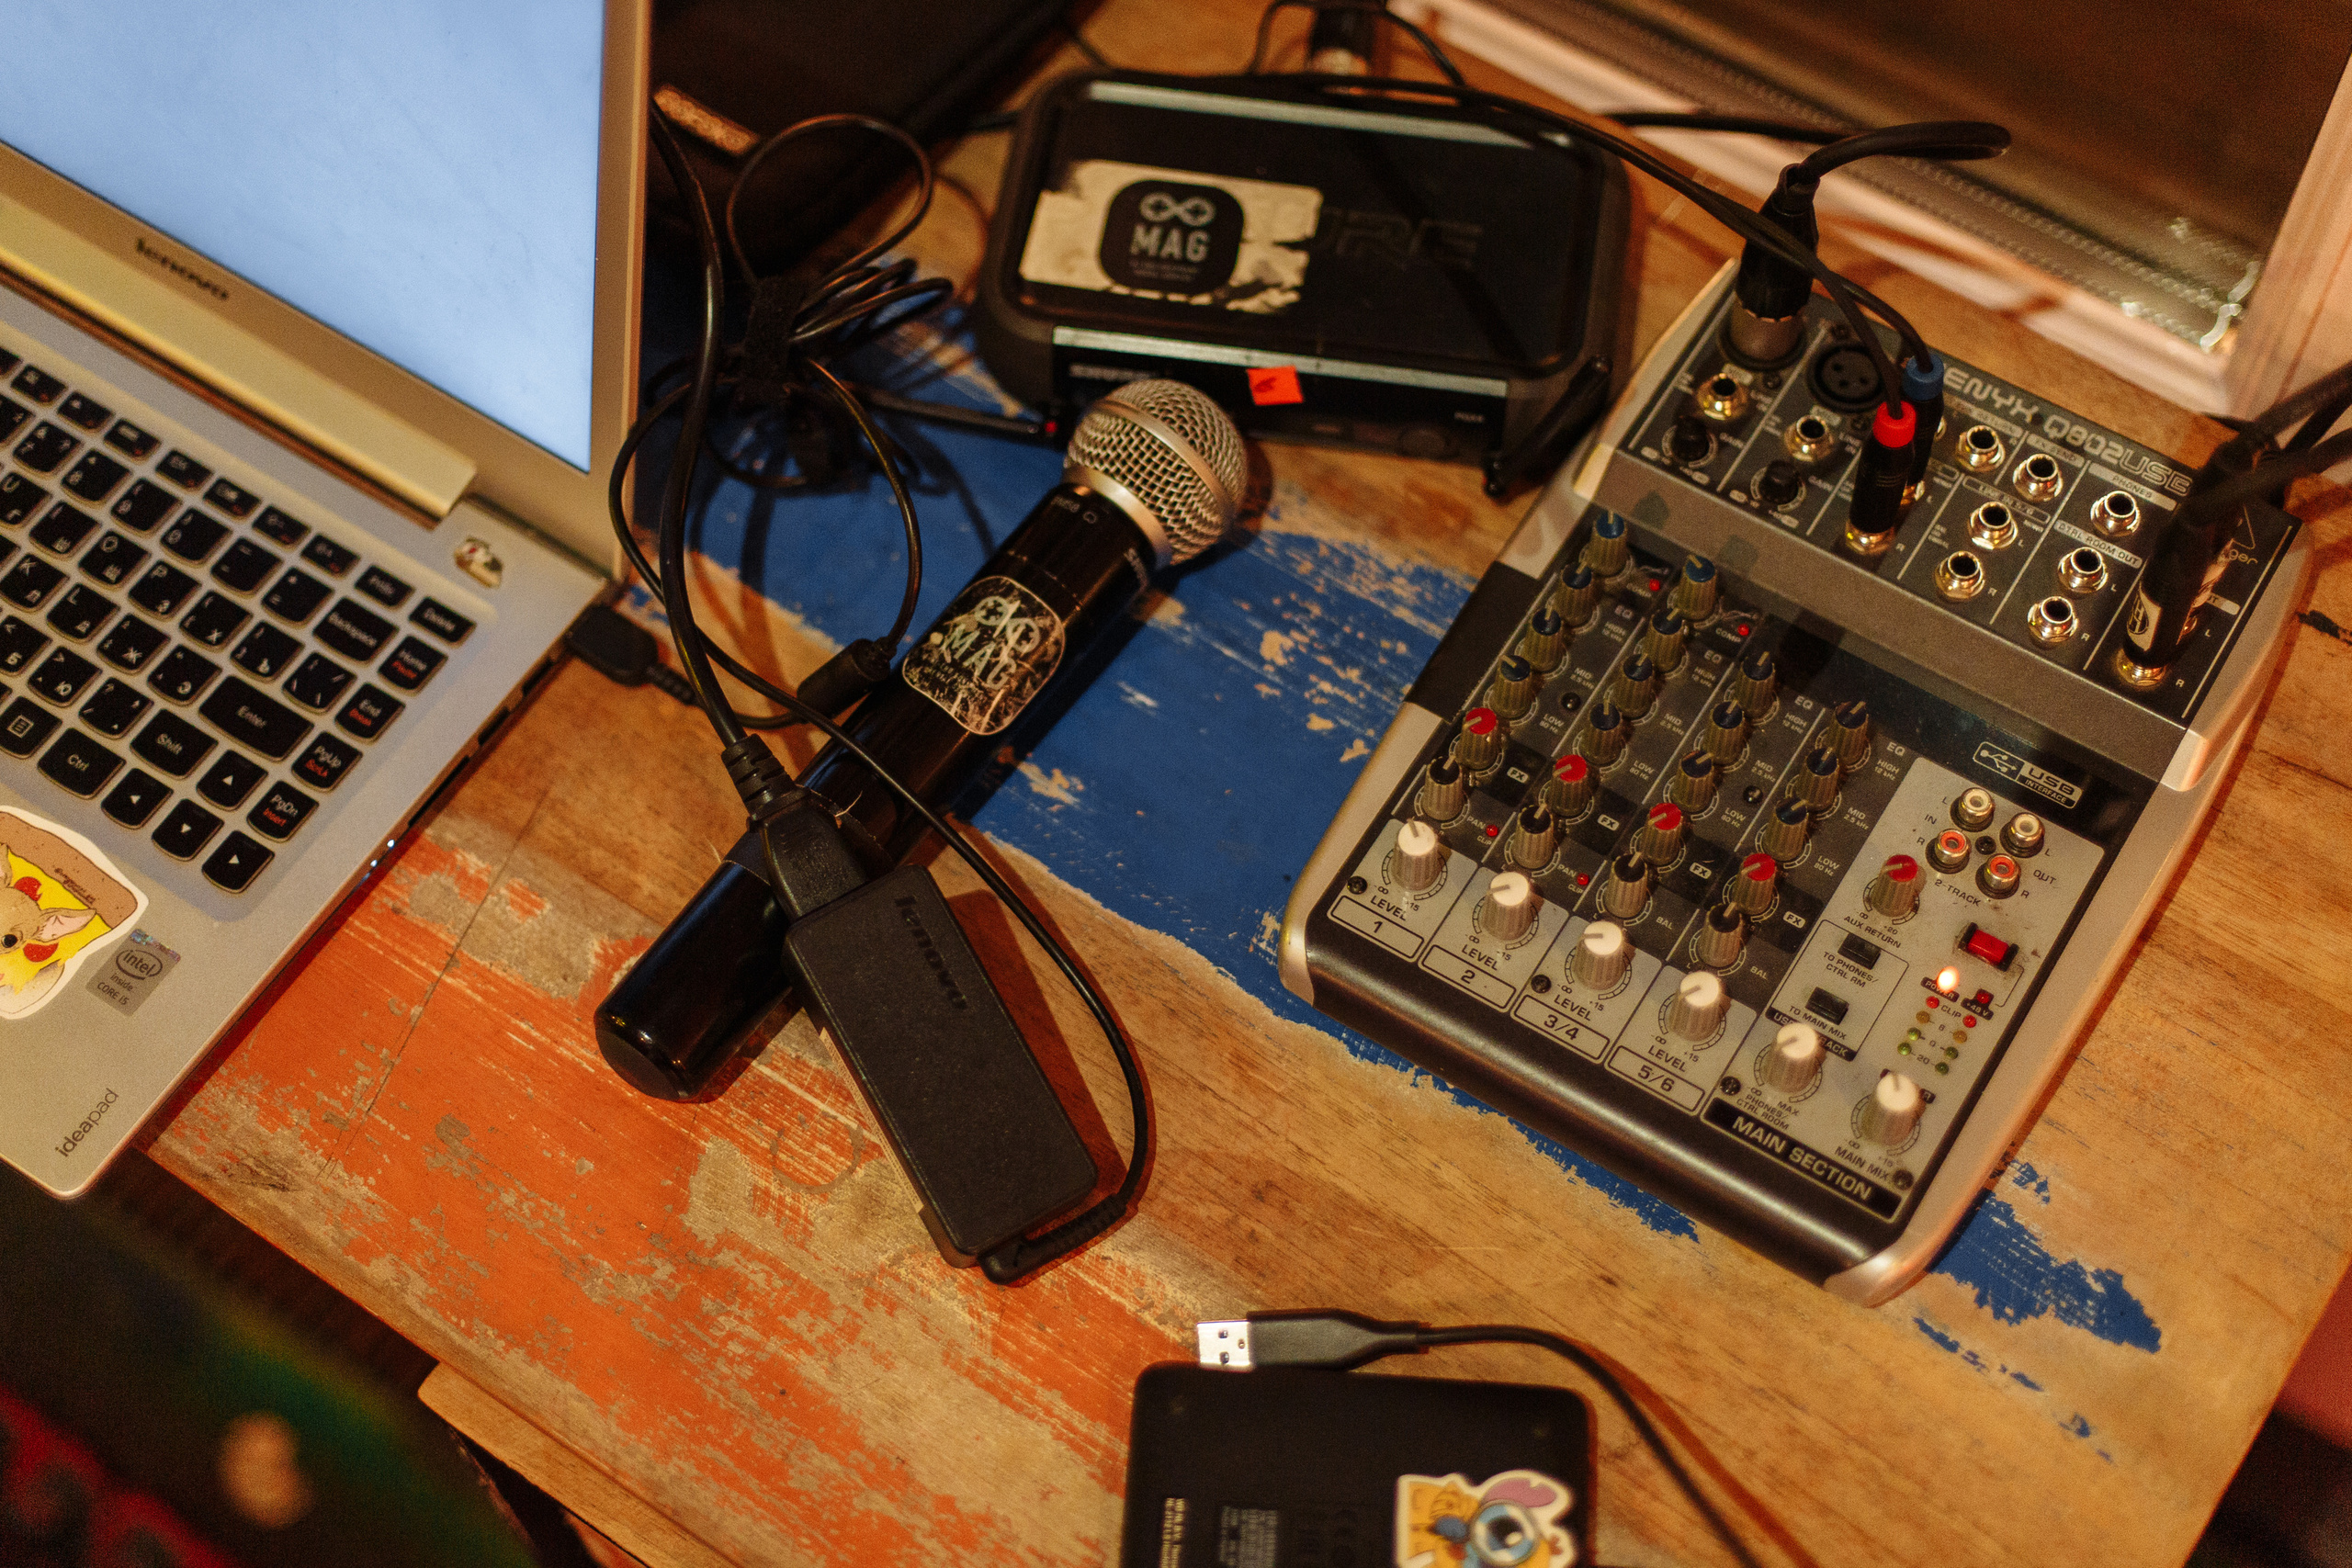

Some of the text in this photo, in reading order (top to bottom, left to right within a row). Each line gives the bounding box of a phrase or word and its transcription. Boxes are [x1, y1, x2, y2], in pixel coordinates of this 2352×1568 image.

[1130, 224, 1209, 264] MAG
[1943, 364, 2040, 424] ENYX
[2114, 476, 2153, 499] PHONES
[2086, 536, 2117, 555] ROOM
[2118, 551, 2139, 566] OUT
[18, 558, 37, 577] K
[6, 651, 23, 666] Б
[121, 647, 142, 664] Ж
[939, 623, 1017, 689] MAG
[1704, 649, 1723, 664] EQ
[1574, 667, 1593, 680] MID
[55, 681, 73, 696] Ю
[176, 681, 192, 695] Э
[1794, 695, 1814, 710] EQ
[235, 705, 267, 729] Enter
[1544, 713, 1565, 727] LOW
[1664, 713, 1683, 726] MID
[156, 733, 183, 755] Shift
[1886, 741, 1906, 757] EQ
[67, 753, 90, 773] Ctrl
[314, 745, 342, 769] PgUp
[1634, 760, 1655, 774] LOW
[1755, 759, 1774, 773] MID
[1877, 759, 1900, 774] HIGH
[1510, 770, 1526, 780] FX
[2028, 767, 2075, 795] USB
[2024, 779, 2067, 804] INTERFACE
[269, 794, 299, 817] PgDn
[263, 807, 287, 827] Insert
[1724, 807, 1746, 821] LOW
[1843, 814, 1856, 824] 2.5
[1848, 807, 1866, 820] MID
[1924, 814, 1937, 825] IN
[1467, 816, 1486, 829] PAN
[1601, 817, 1615, 828] FX
[1731, 818, 1741, 828] Hz
[1476, 835, 1492, 846] CLIP
[1917, 837, 1926, 846] R
[2044, 848, 2051, 856] L
[1692, 864, 1708, 876] FX
[1814, 863, 1834, 876] 80 Hz
[1817, 855, 1839, 870] LOW
[1557, 863, 1577, 878] PAN
[2033, 869, 2057, 885] OUT
[1567, 884, 1583, 895] CLIP
[1934, 879, 1982, 907] 2-TRACK
[2021, 890, 2030, 898] R
[1370, 895, 1407, 921] LEVEL
[1374, 920, 1383, 933] 1
[1657, 917, 1673, 930] BAL
[1786, 914, 1801, 926] FX
[1844, 915, 1902, 949] AUX RETURN
[123, 950, 156, 976] intel
[1461, 943, 1498, 971] LEVEL
[1750, 966, 1768, 980] BAL
[1823, 951, 1879, 983] TO PHONES/
[110, 973, 133, 991] inside
[1460, 969, 1476, 984] 2
[1826, 963, 1867, 988] CTRL RM
[96, 981, 120, 999] CORE
[1554, 994, 1591, 1021] LEVEL
[1940, 1005, 1962, 1019] CLIP
[1544, 1014, 1579, 1041] 3/4
[1790, 1006, 1847, 1040] TO MAIN MIX
[1647, 1045, 1686, 1073] LEVEL
[1683, 1050, 1699, 1064] +15
[1637, 1065, 1675, 1092] 5/6
[1736, 1098, 1790, 1130] CTRL ROOM
[1746, 1094, 1788, 1120] PHONES/
[1777, 1101, 1800, 1116] MAX
[55, 1089, 119, 1157] ideapad
[1732, 1116, 1872, 1200] MAIN SECTION
[1835, 1146, 1890, 1181] MAIN MIX
